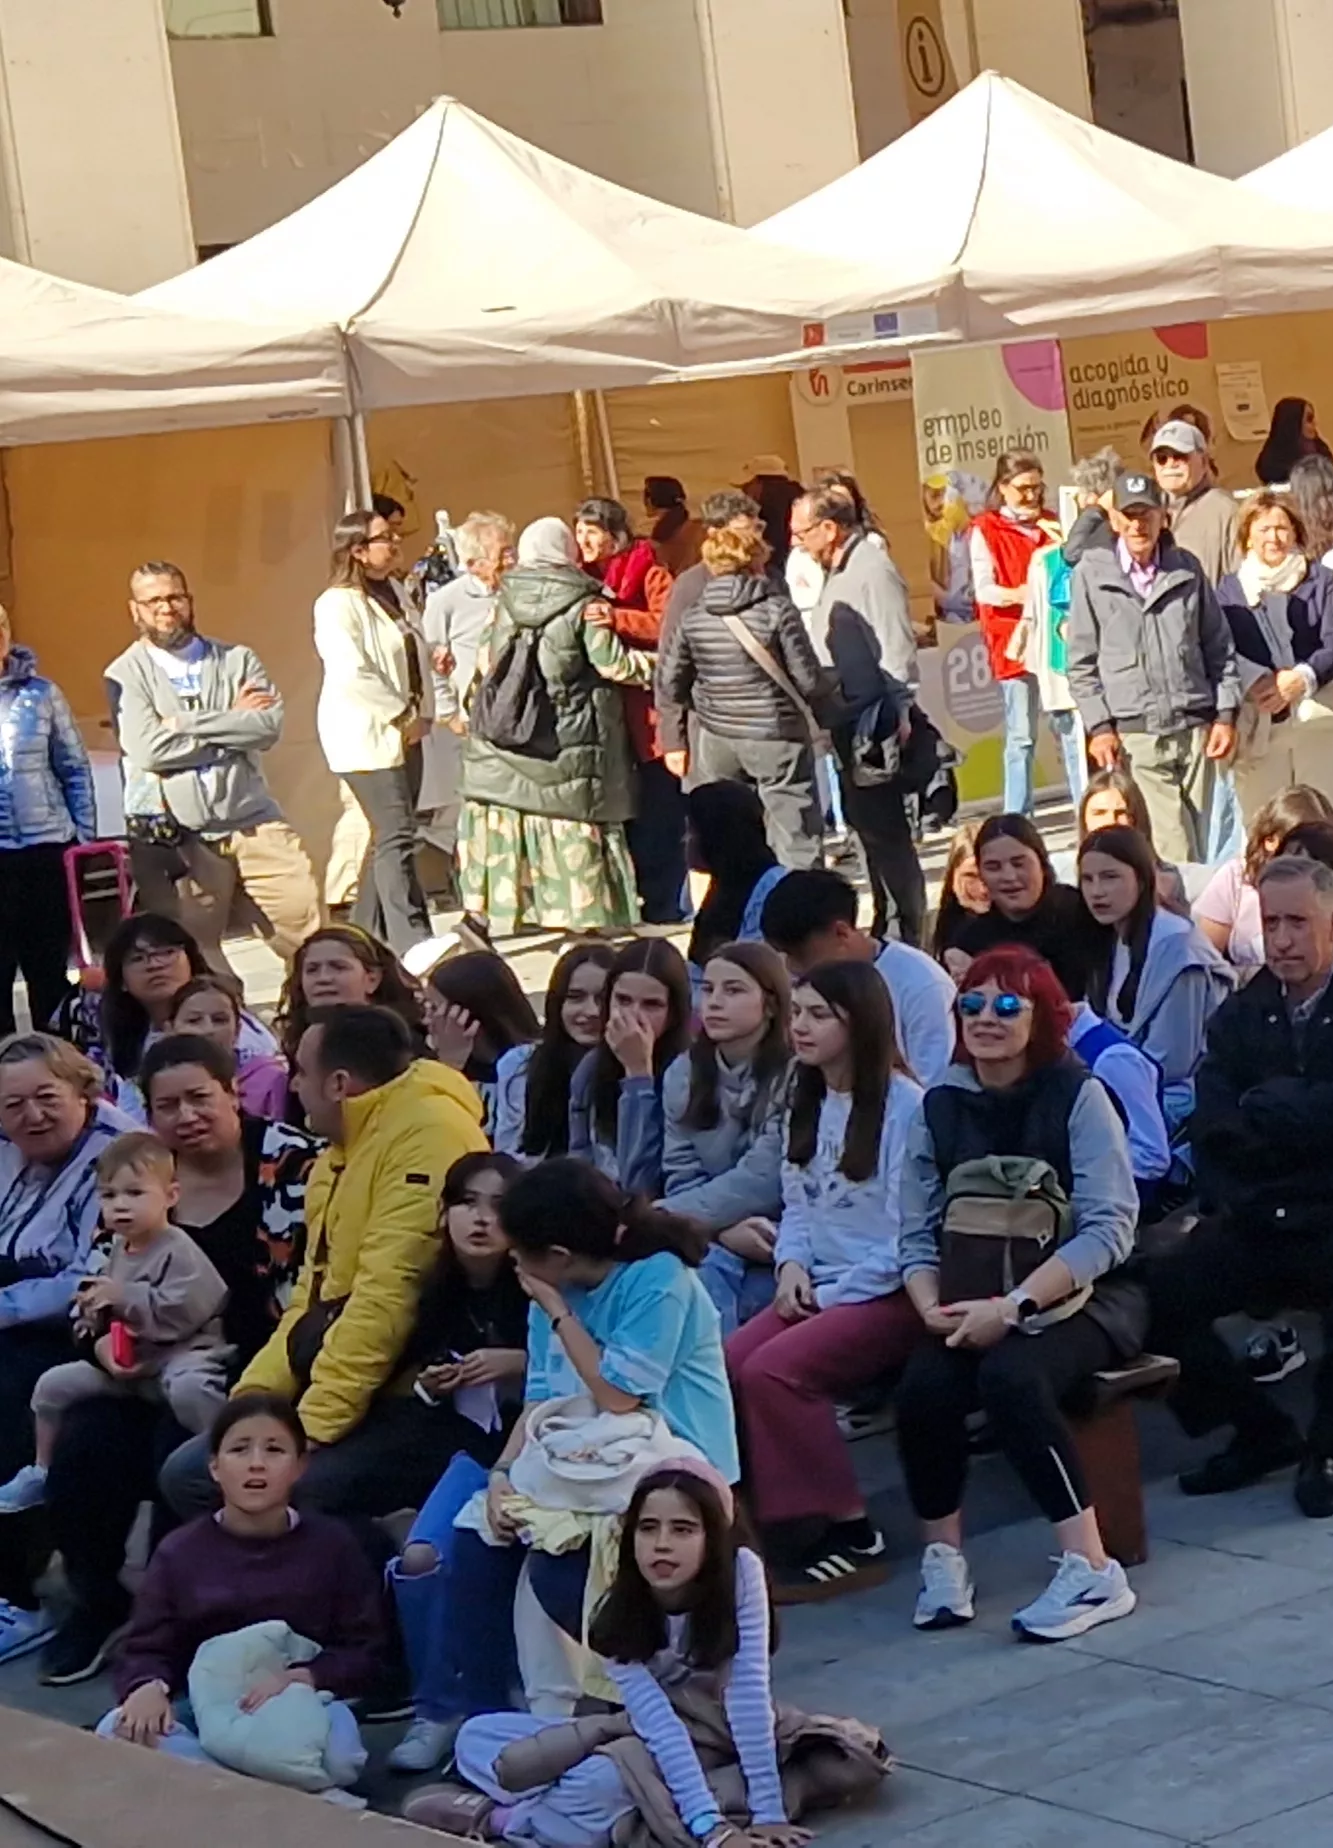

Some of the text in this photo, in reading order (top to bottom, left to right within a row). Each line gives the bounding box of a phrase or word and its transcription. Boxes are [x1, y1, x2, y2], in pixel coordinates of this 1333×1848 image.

[1069, 353, 1169, 384] acogida y
[1072, 376, 1190, 410] diagnóstico
[923, 405, 1002, 438] empleo
[925, 438, 952, 467] de
[956, 424, 1049, 463] inserción
[947, 643, 992, 692] 28
